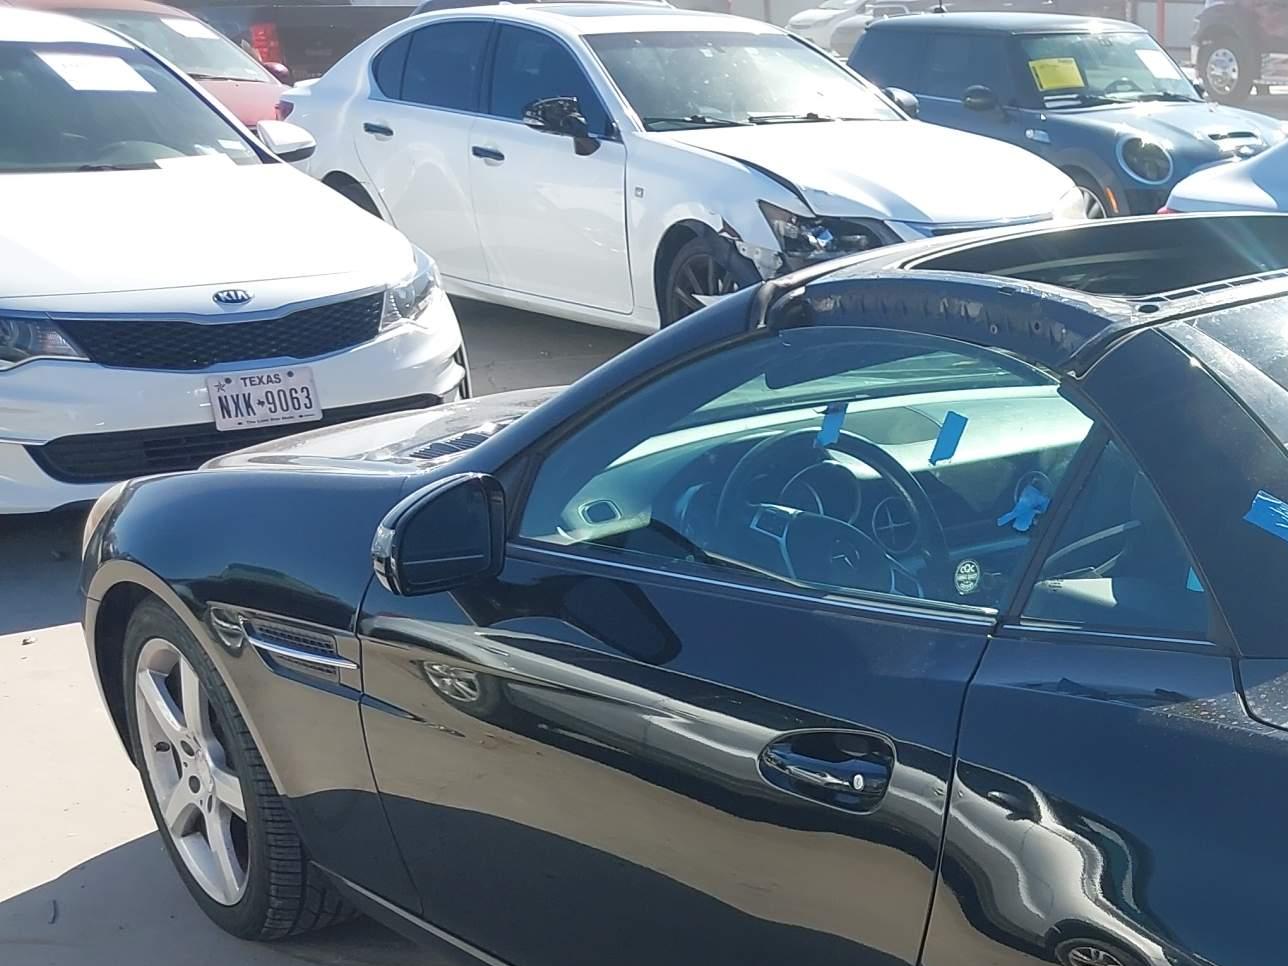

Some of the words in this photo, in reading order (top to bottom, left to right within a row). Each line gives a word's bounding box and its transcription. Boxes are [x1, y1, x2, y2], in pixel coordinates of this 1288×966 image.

[218, 290, 250, 302] KIA
[240, 373, 282, 388] TEXAS
[218, 392, 257, 420] NXK
[264, 386, 313, 414] 9063
